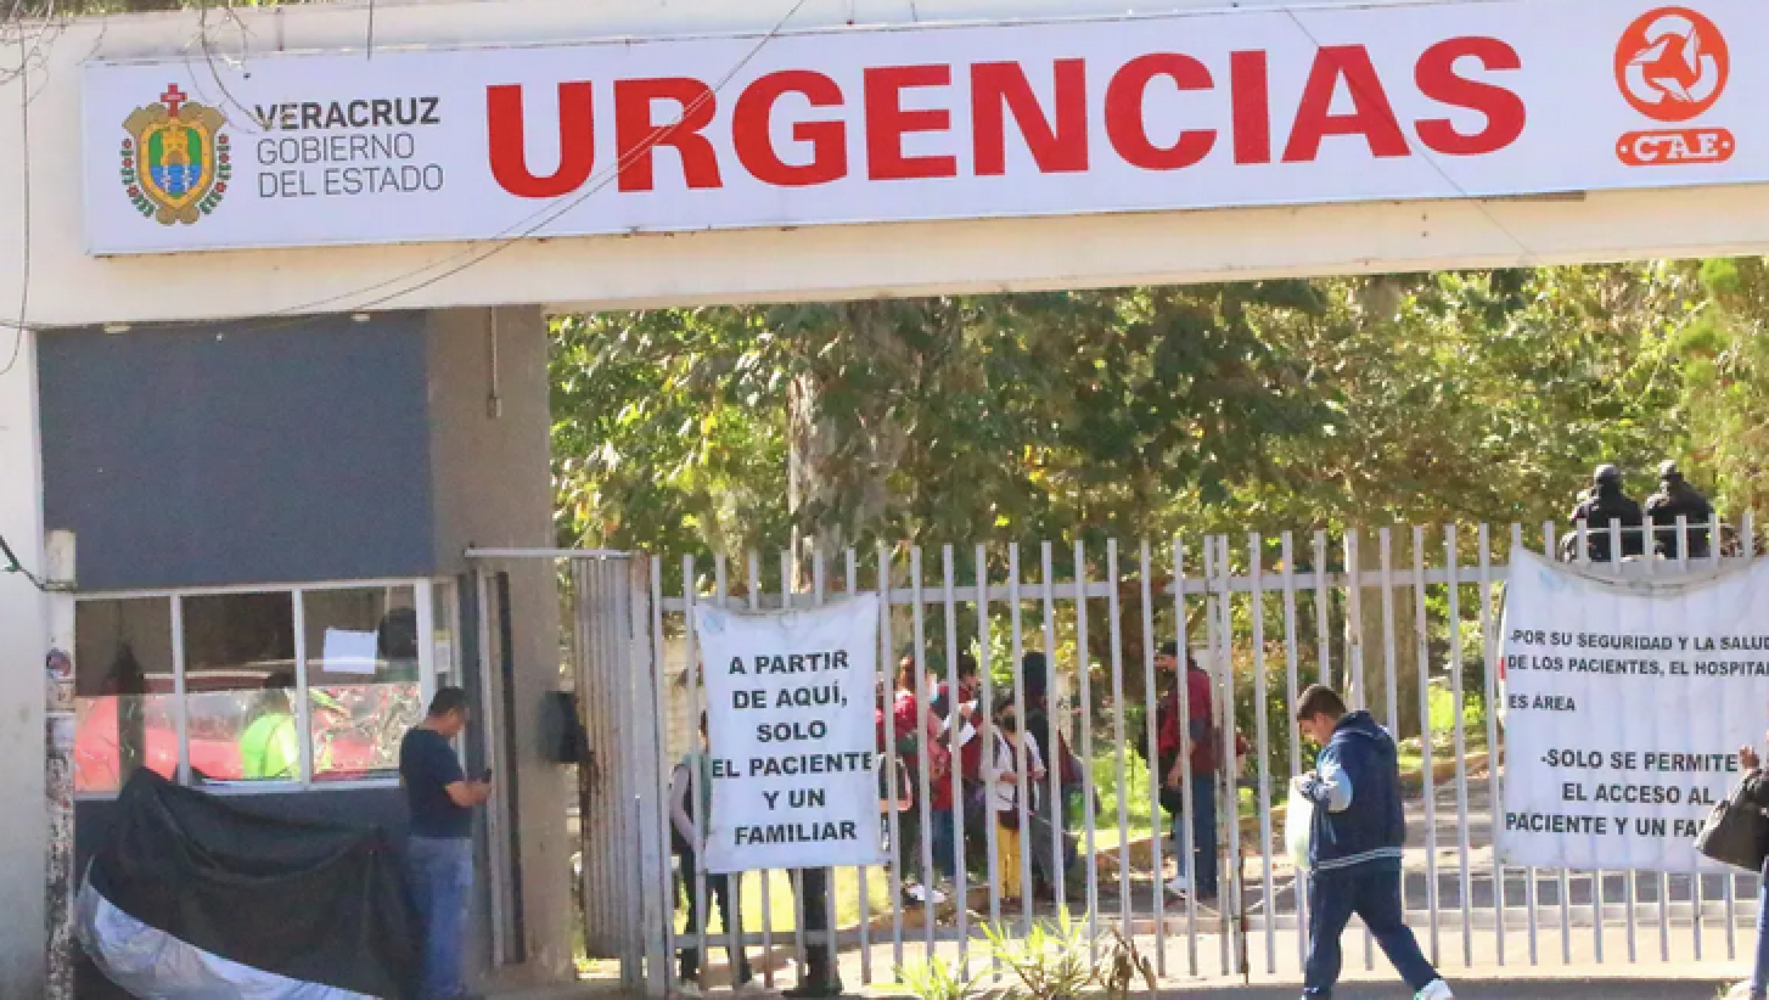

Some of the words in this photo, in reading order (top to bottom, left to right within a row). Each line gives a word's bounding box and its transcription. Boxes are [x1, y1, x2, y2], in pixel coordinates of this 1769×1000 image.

[255, 97, 440, 131] VERACRUZ
[486, 35, 1527, 199] URGENCIAS
[257, 131, 414, 165] GOBIERNO
[257, 169, 317, 198] DEL
[323, 162, 444, 196] ESTADO
[1549, 631, 1573, 646] SU
[1576, 632, 1673, 651] SEGURIDAD
[1678, 636, 1689, 651] Y
[1693, 636, 1716, 651] LA
[728, 656, 748, 675] A
[754, 649, 850, 675] PARTIR
[1507, 654, 1527, 670] DE
[1532, 655, 1564, 672] LOS
[1568, 658, 1666, 678] PACIENTES,
[1669, 661, 1690, 675] EL
[732, 690, 767, 709] DE
[775, 680, 848, 709] AQUÍ,
[1508, 693, 1529, 710] ES
[756, 719, 828, 743] SOLO
[710, 758, 741, 779] EL
[749, 751, 872, 777] PACIENTE
[1610, 751, 1637, 770] SE
[1644, 752, 1738, 771] PERMITE
[763, 790, 780, 811] Y
[788, 788, 826, 809] UN
[1561, 782, 1588, 802] EL
[1593, 783, 1682, 804] ACCESO
[1687, 785, 1716, 806] AL
[734, 819, 857, 846] FAMILIAR
[1505, 812, 1607, 835] PACIENTE
[1614, 816, 1629, 836] Y
[1635, 817, 1666, 838] UN
